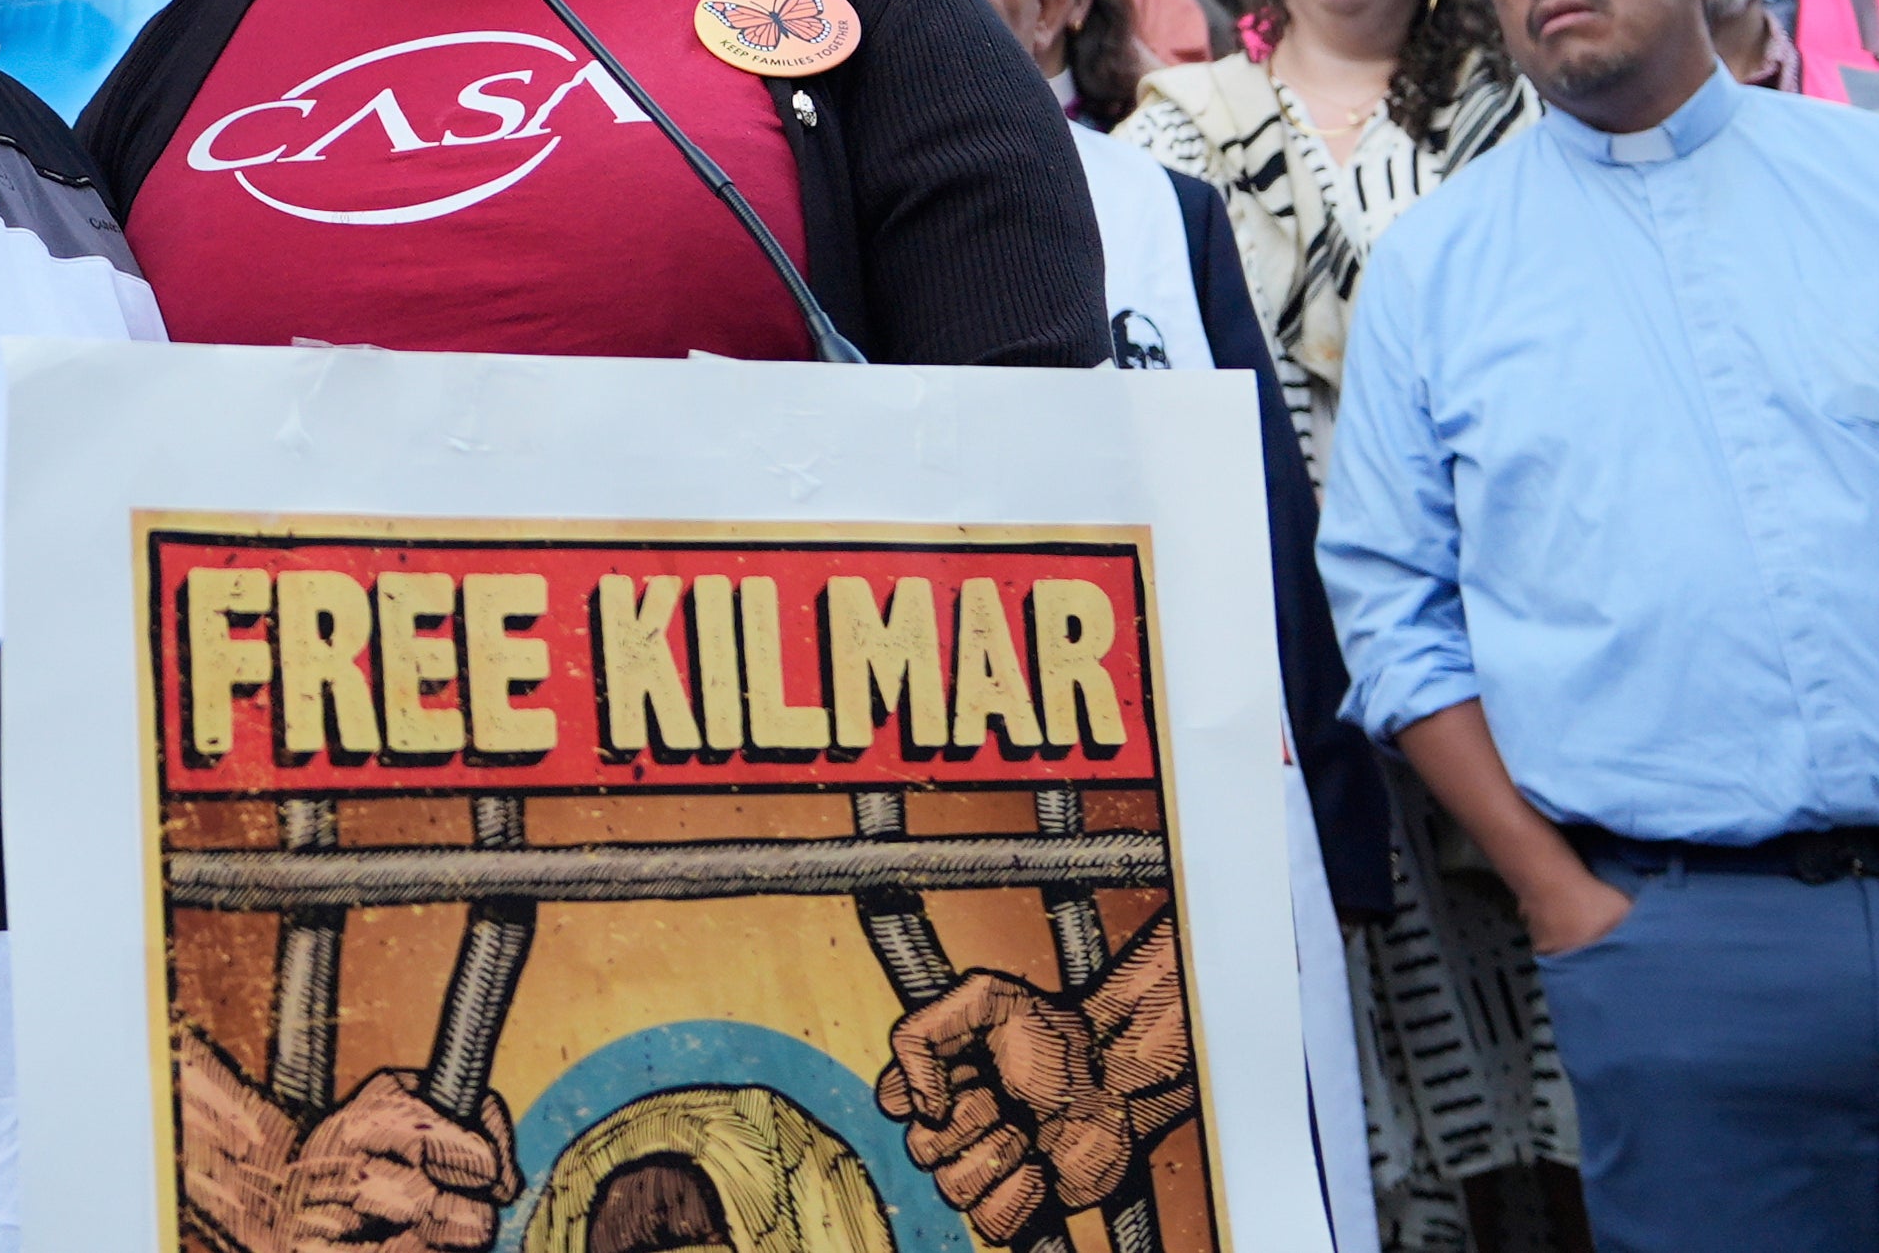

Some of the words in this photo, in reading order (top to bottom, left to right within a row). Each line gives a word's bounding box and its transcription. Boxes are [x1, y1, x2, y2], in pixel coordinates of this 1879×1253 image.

[720, 39, 749, 58] KEEP
[751, 55, 815, 68] FAMILIES
[815, 19, 850, 60] TOGETHER
[186, 59, 653, 172] CASA
[183, 567, 558, 763] FREE
[591, 573, 1125, 765] KILMAR
